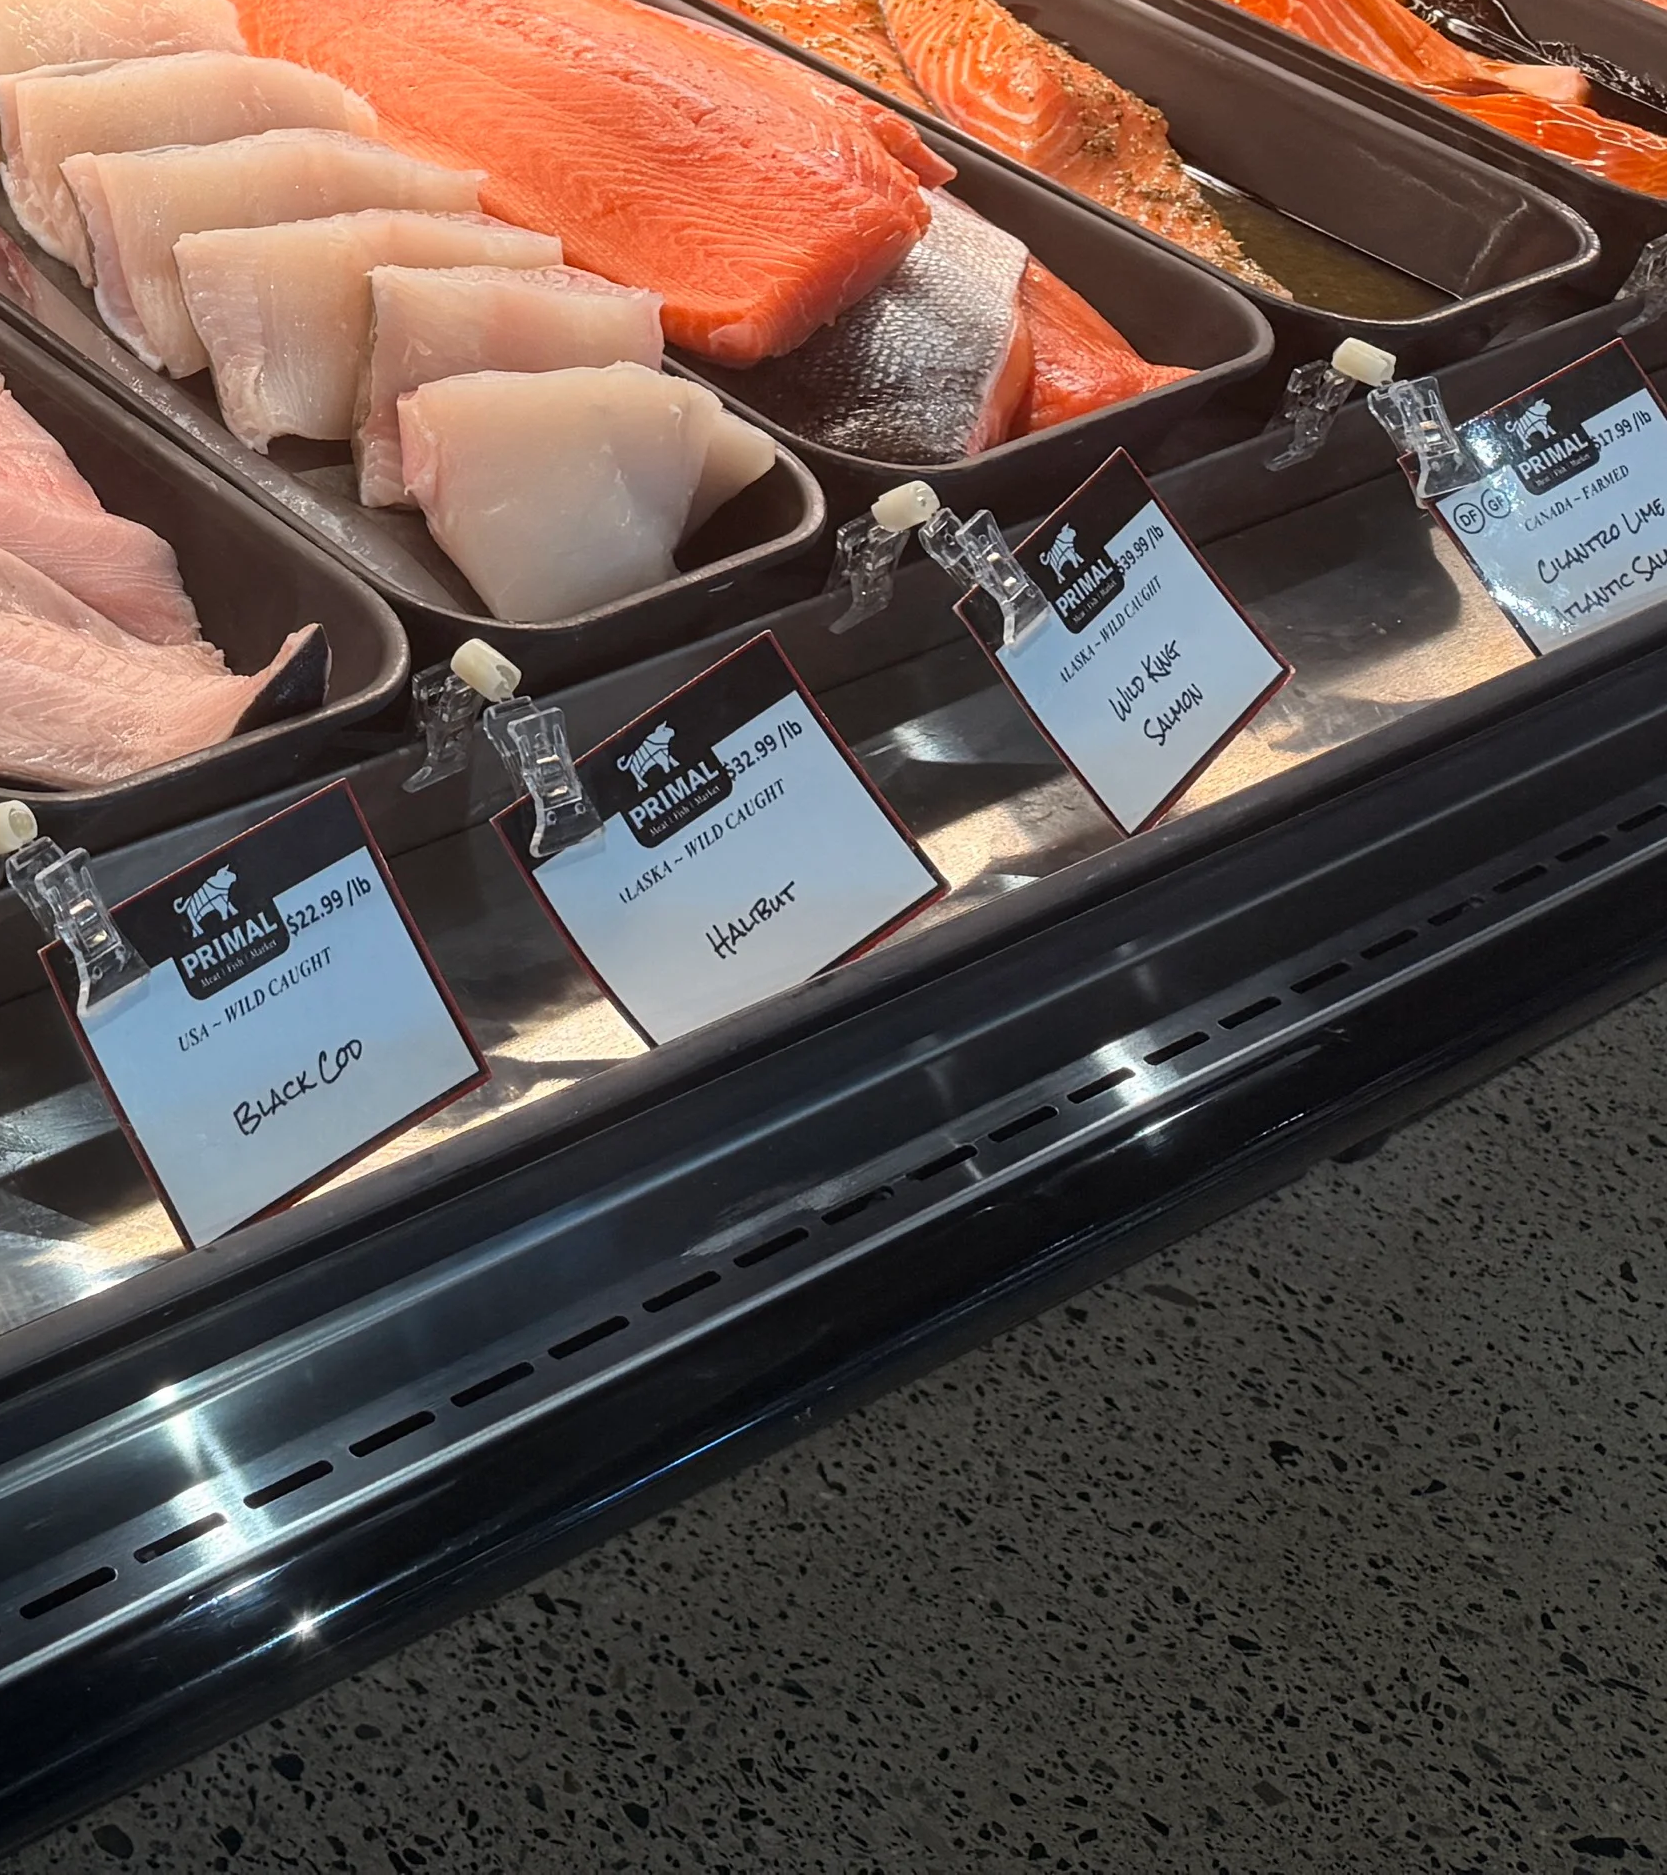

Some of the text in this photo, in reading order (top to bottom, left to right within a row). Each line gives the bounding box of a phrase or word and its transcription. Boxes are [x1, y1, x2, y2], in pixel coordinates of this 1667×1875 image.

[1517, 433, 1589, 481] PRIMAL
[1591, 410, 1652, 452] $17.99 /lb
[1459, 496, 1504, 527] DF GF
[1525, 464, 1629, 531] CANADA FARMED
[1116, 525, 1164, 577] $39.99 /lb
[1538, 498, 1665, 584] CILANTRO LIME
[1055, 559, 1113, 617] PRIMAL
[1100, 613, 1125, 643] WILD
[1124, 575, 1162, 618] CAUGHT
[1108, 641, 1181, 722] WILD KING
[1144, 683, 1203, 746] SALMON
[723, 718, 802, 783] $32.99 /lb
[628, 761, 719, 830] PRIMAL
[684, 824, 724, 858] WILD
[725, 778, 786, 829] CAUGHT
[694, 785, 721, 805] Market
[286, 877, 371, 936] $22.99 /lb
[705, 881, 795, 959] HALIBUT
[180, 911, 277, 979] PRIMAL
[227, 960, 244, 972] Fish
[250, 939, 277, 959] Market
[179, 947, 331, 1051] USA WILD CAUGHT
[233, 1038, 362, 1136] BLACK COD
